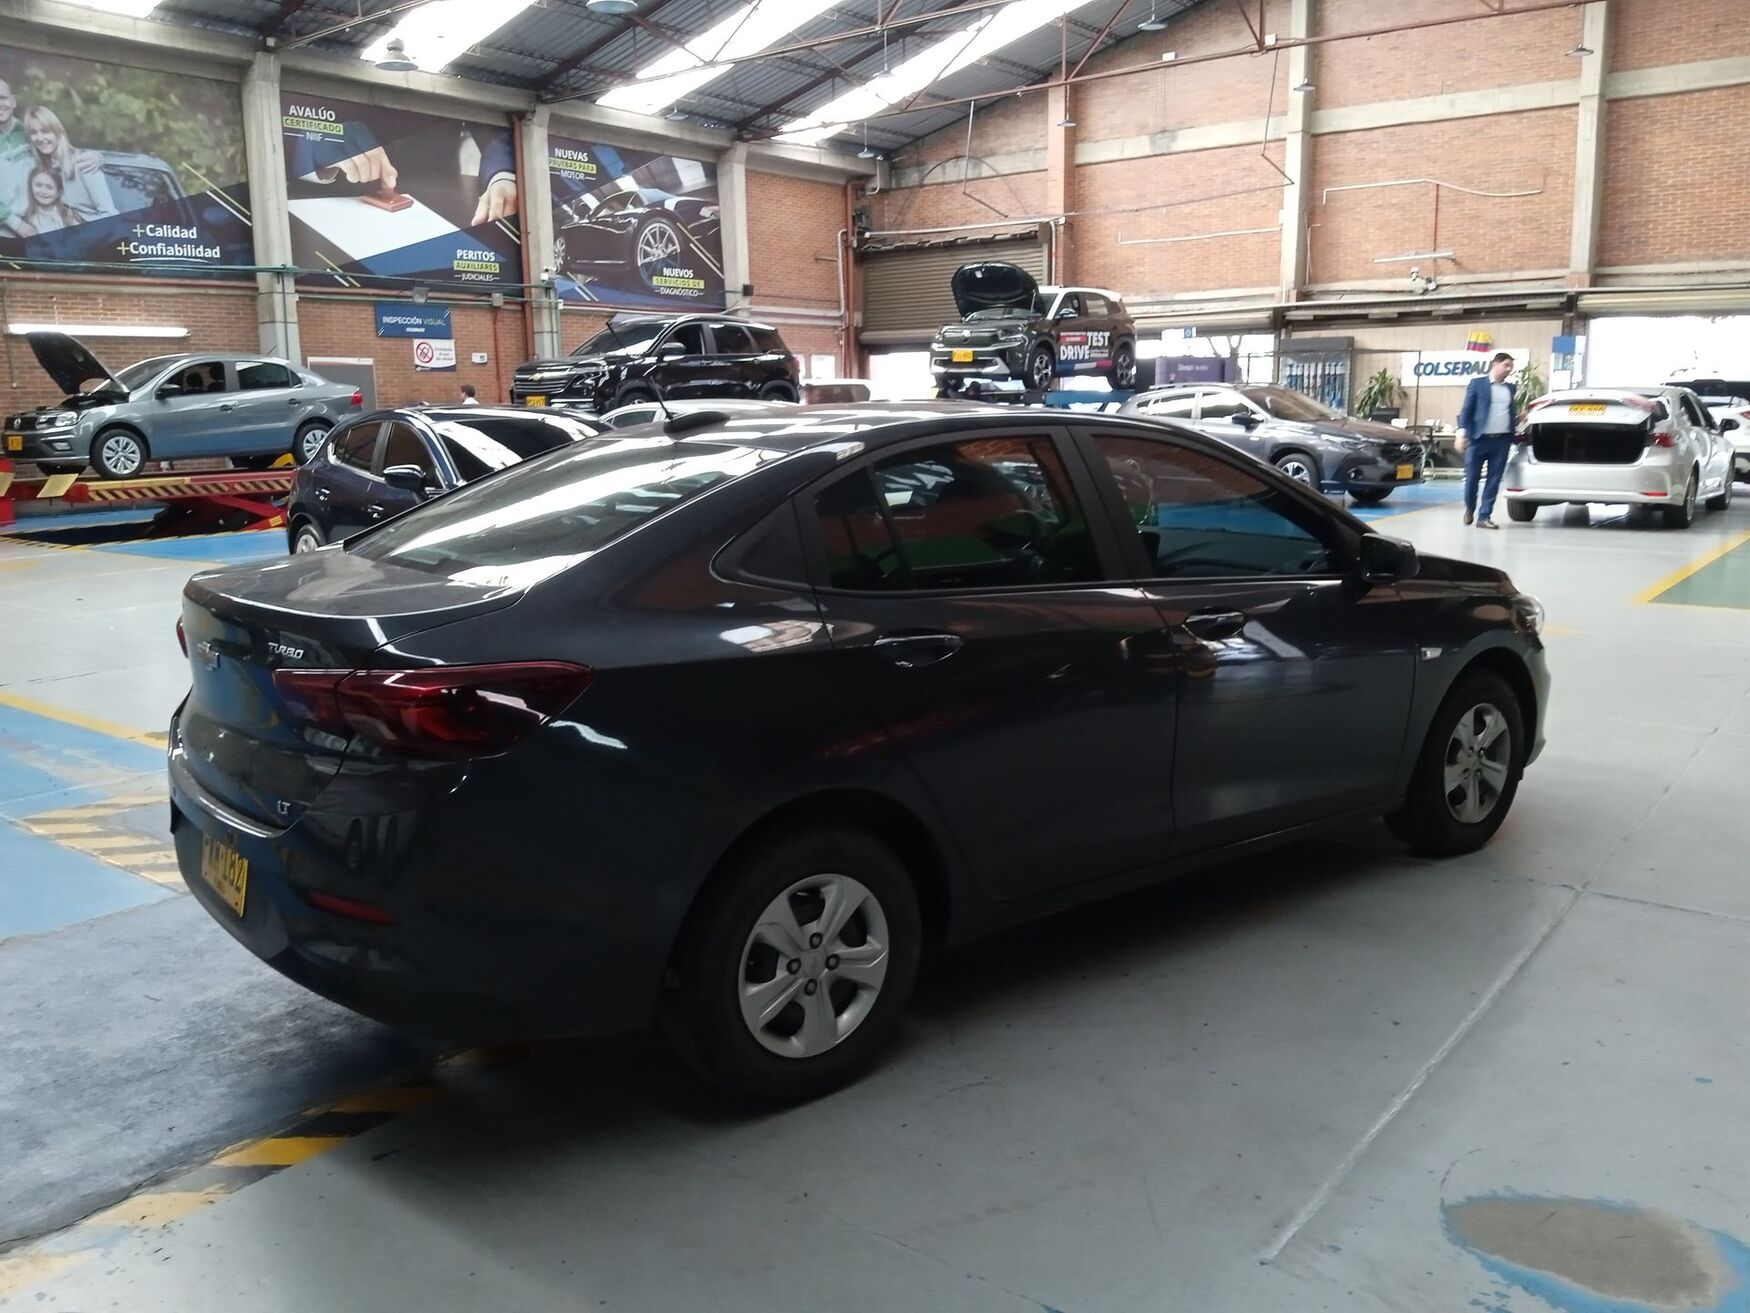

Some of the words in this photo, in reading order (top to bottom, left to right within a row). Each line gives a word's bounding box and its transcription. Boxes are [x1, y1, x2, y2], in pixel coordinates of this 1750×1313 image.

[289, 104, 336, 121] AVALÚO
[284, 117, 342, 134] CERTIFICADO
[554, 148, 588, 161] NUEVAS
[560, 169, 585, 180] MOTOR
[456, 249, 496, 262] PERITOS
[455, 261, 498, 272] AUXILIARES
[663, 267, 693, 278] NUEVOS
[655, 278, 690, 286] SERVICIOS
[1086, 331, 1110, 347] TEST
[1060, 345, 1090, 361] DRIVE
[267, 641, 304, 660] TURBO
